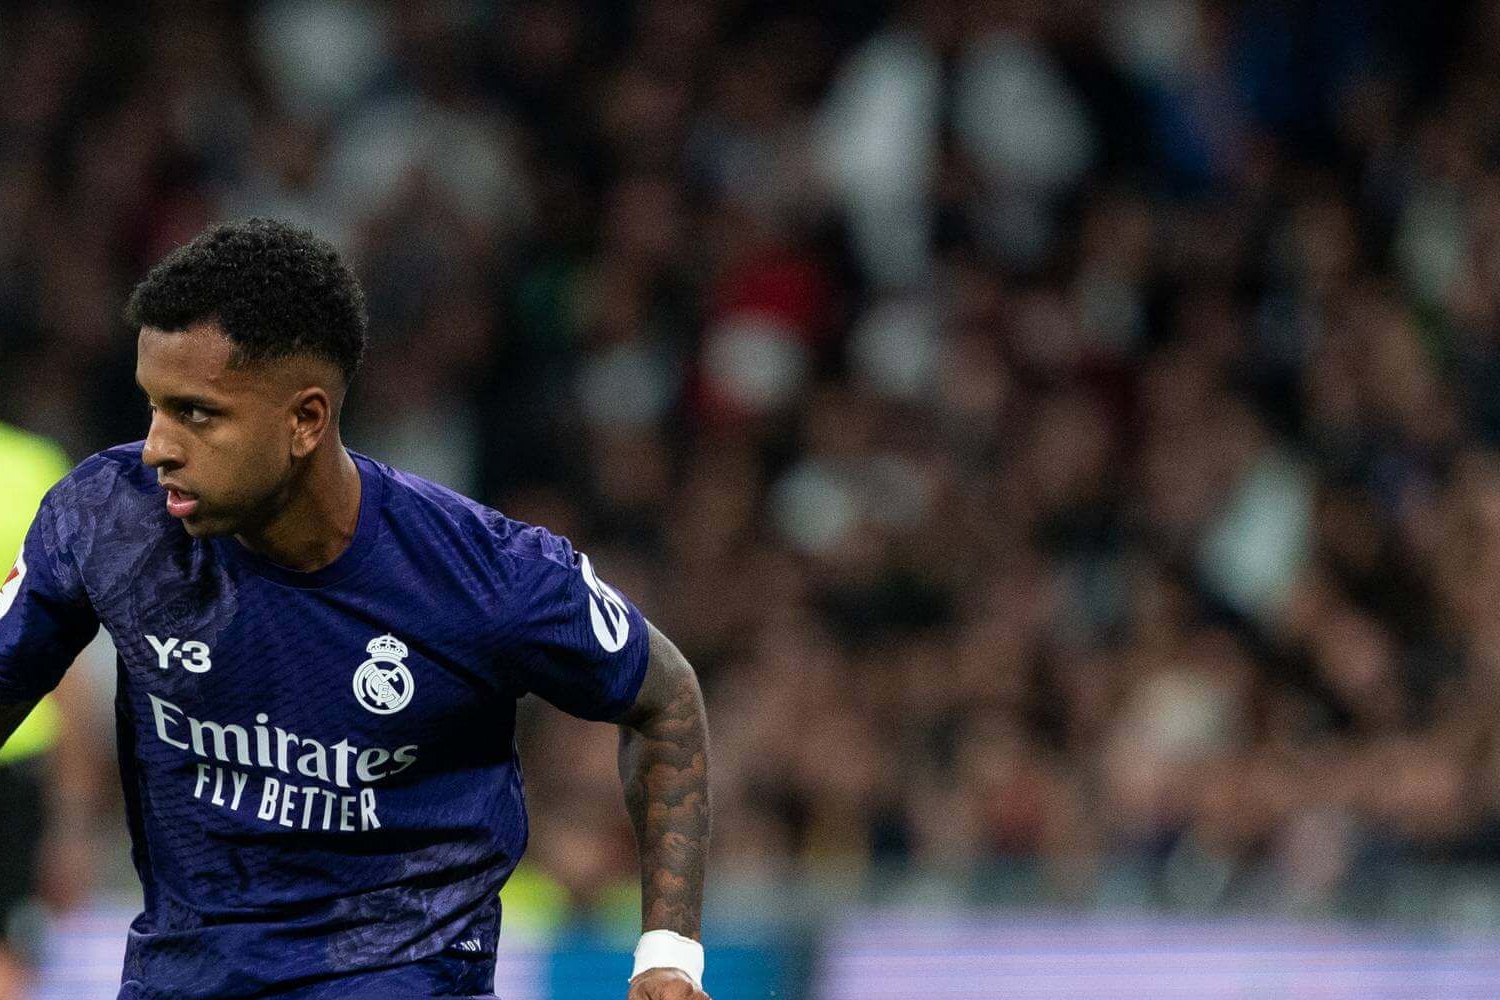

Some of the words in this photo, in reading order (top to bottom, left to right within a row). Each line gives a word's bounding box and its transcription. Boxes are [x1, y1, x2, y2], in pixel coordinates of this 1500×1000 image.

[145, 635, 212, 673] Y-3
[147, 693, 418, 788] Emirates
[194, 763, 248, 811] FLY
[257, 777, 381, 832] BETTER
